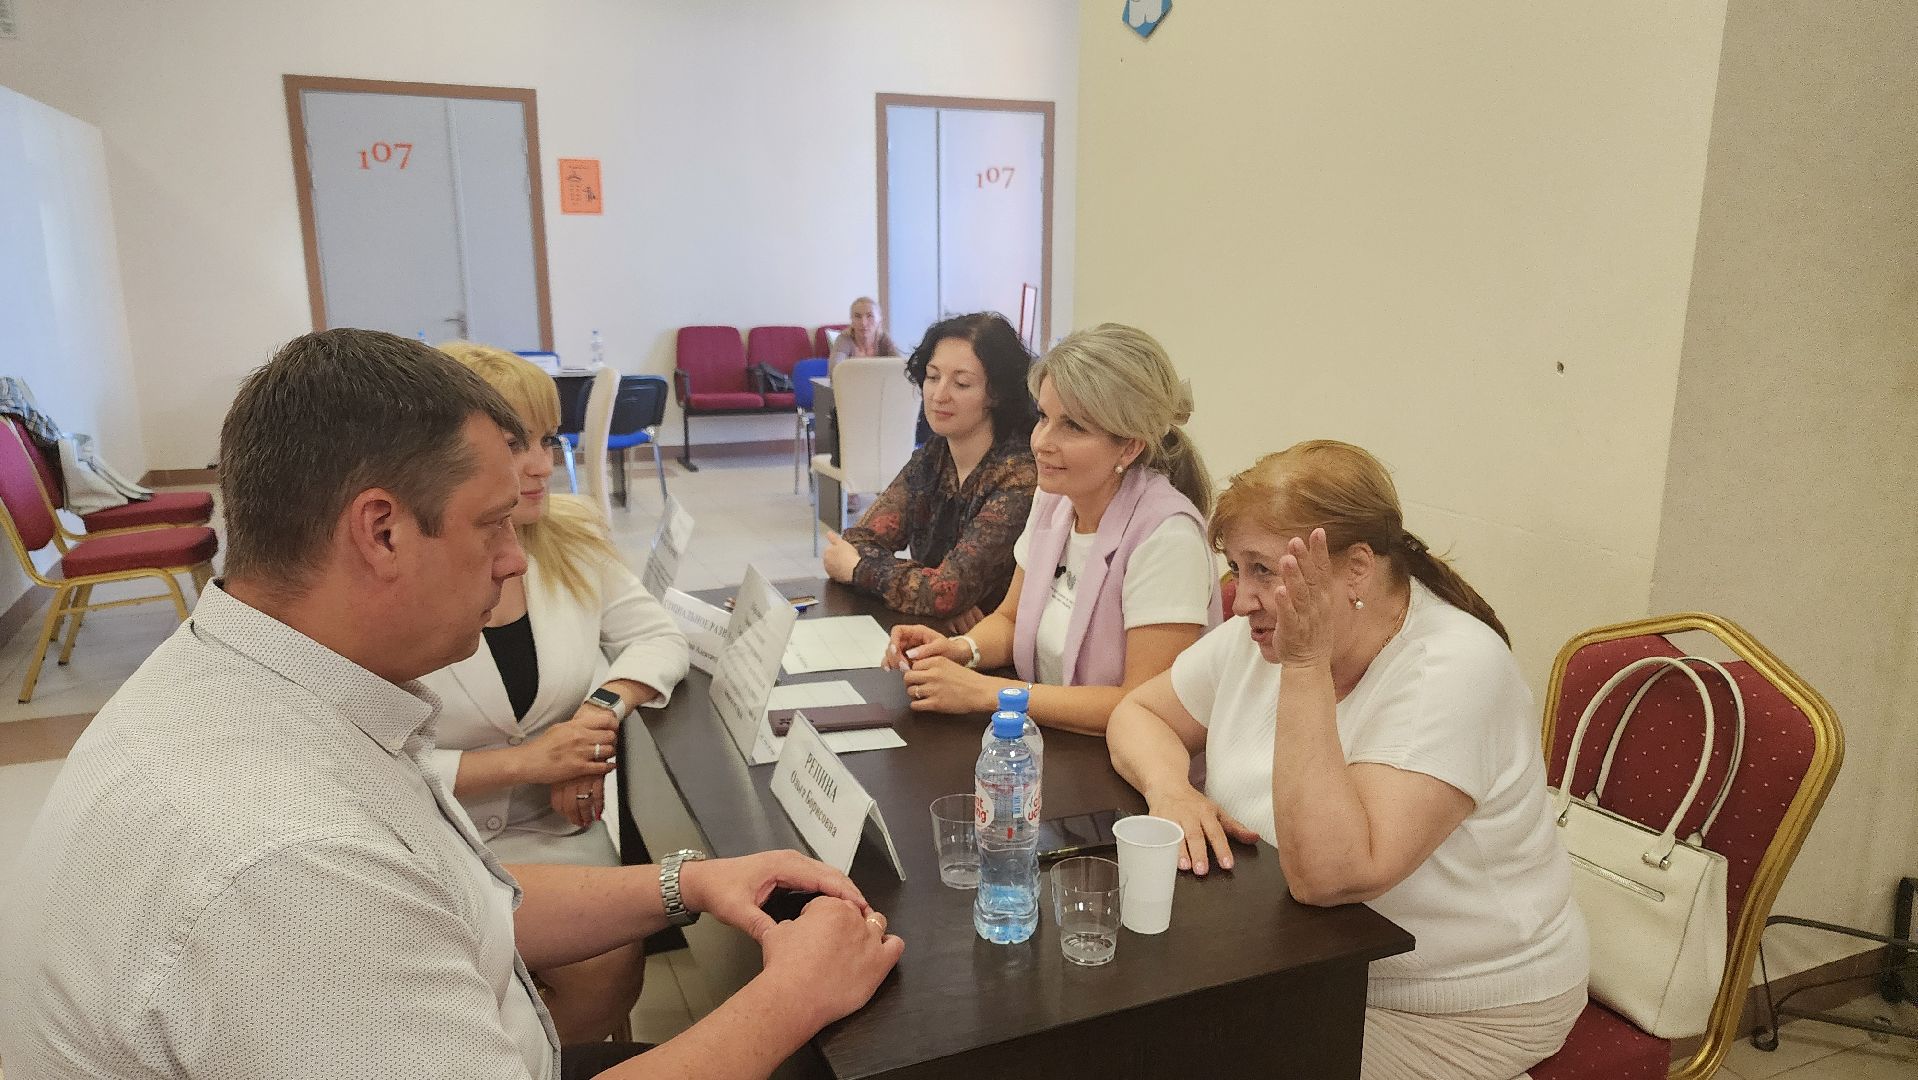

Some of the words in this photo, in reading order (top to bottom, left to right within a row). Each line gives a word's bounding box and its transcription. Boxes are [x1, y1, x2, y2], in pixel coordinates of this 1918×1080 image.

[357, 141, 413, 170] 107
[977, 167, 1015, 189] 107
[804, 752, 838, 803] РЕПИНА
[805, 789, 838, 838] Борисовна
